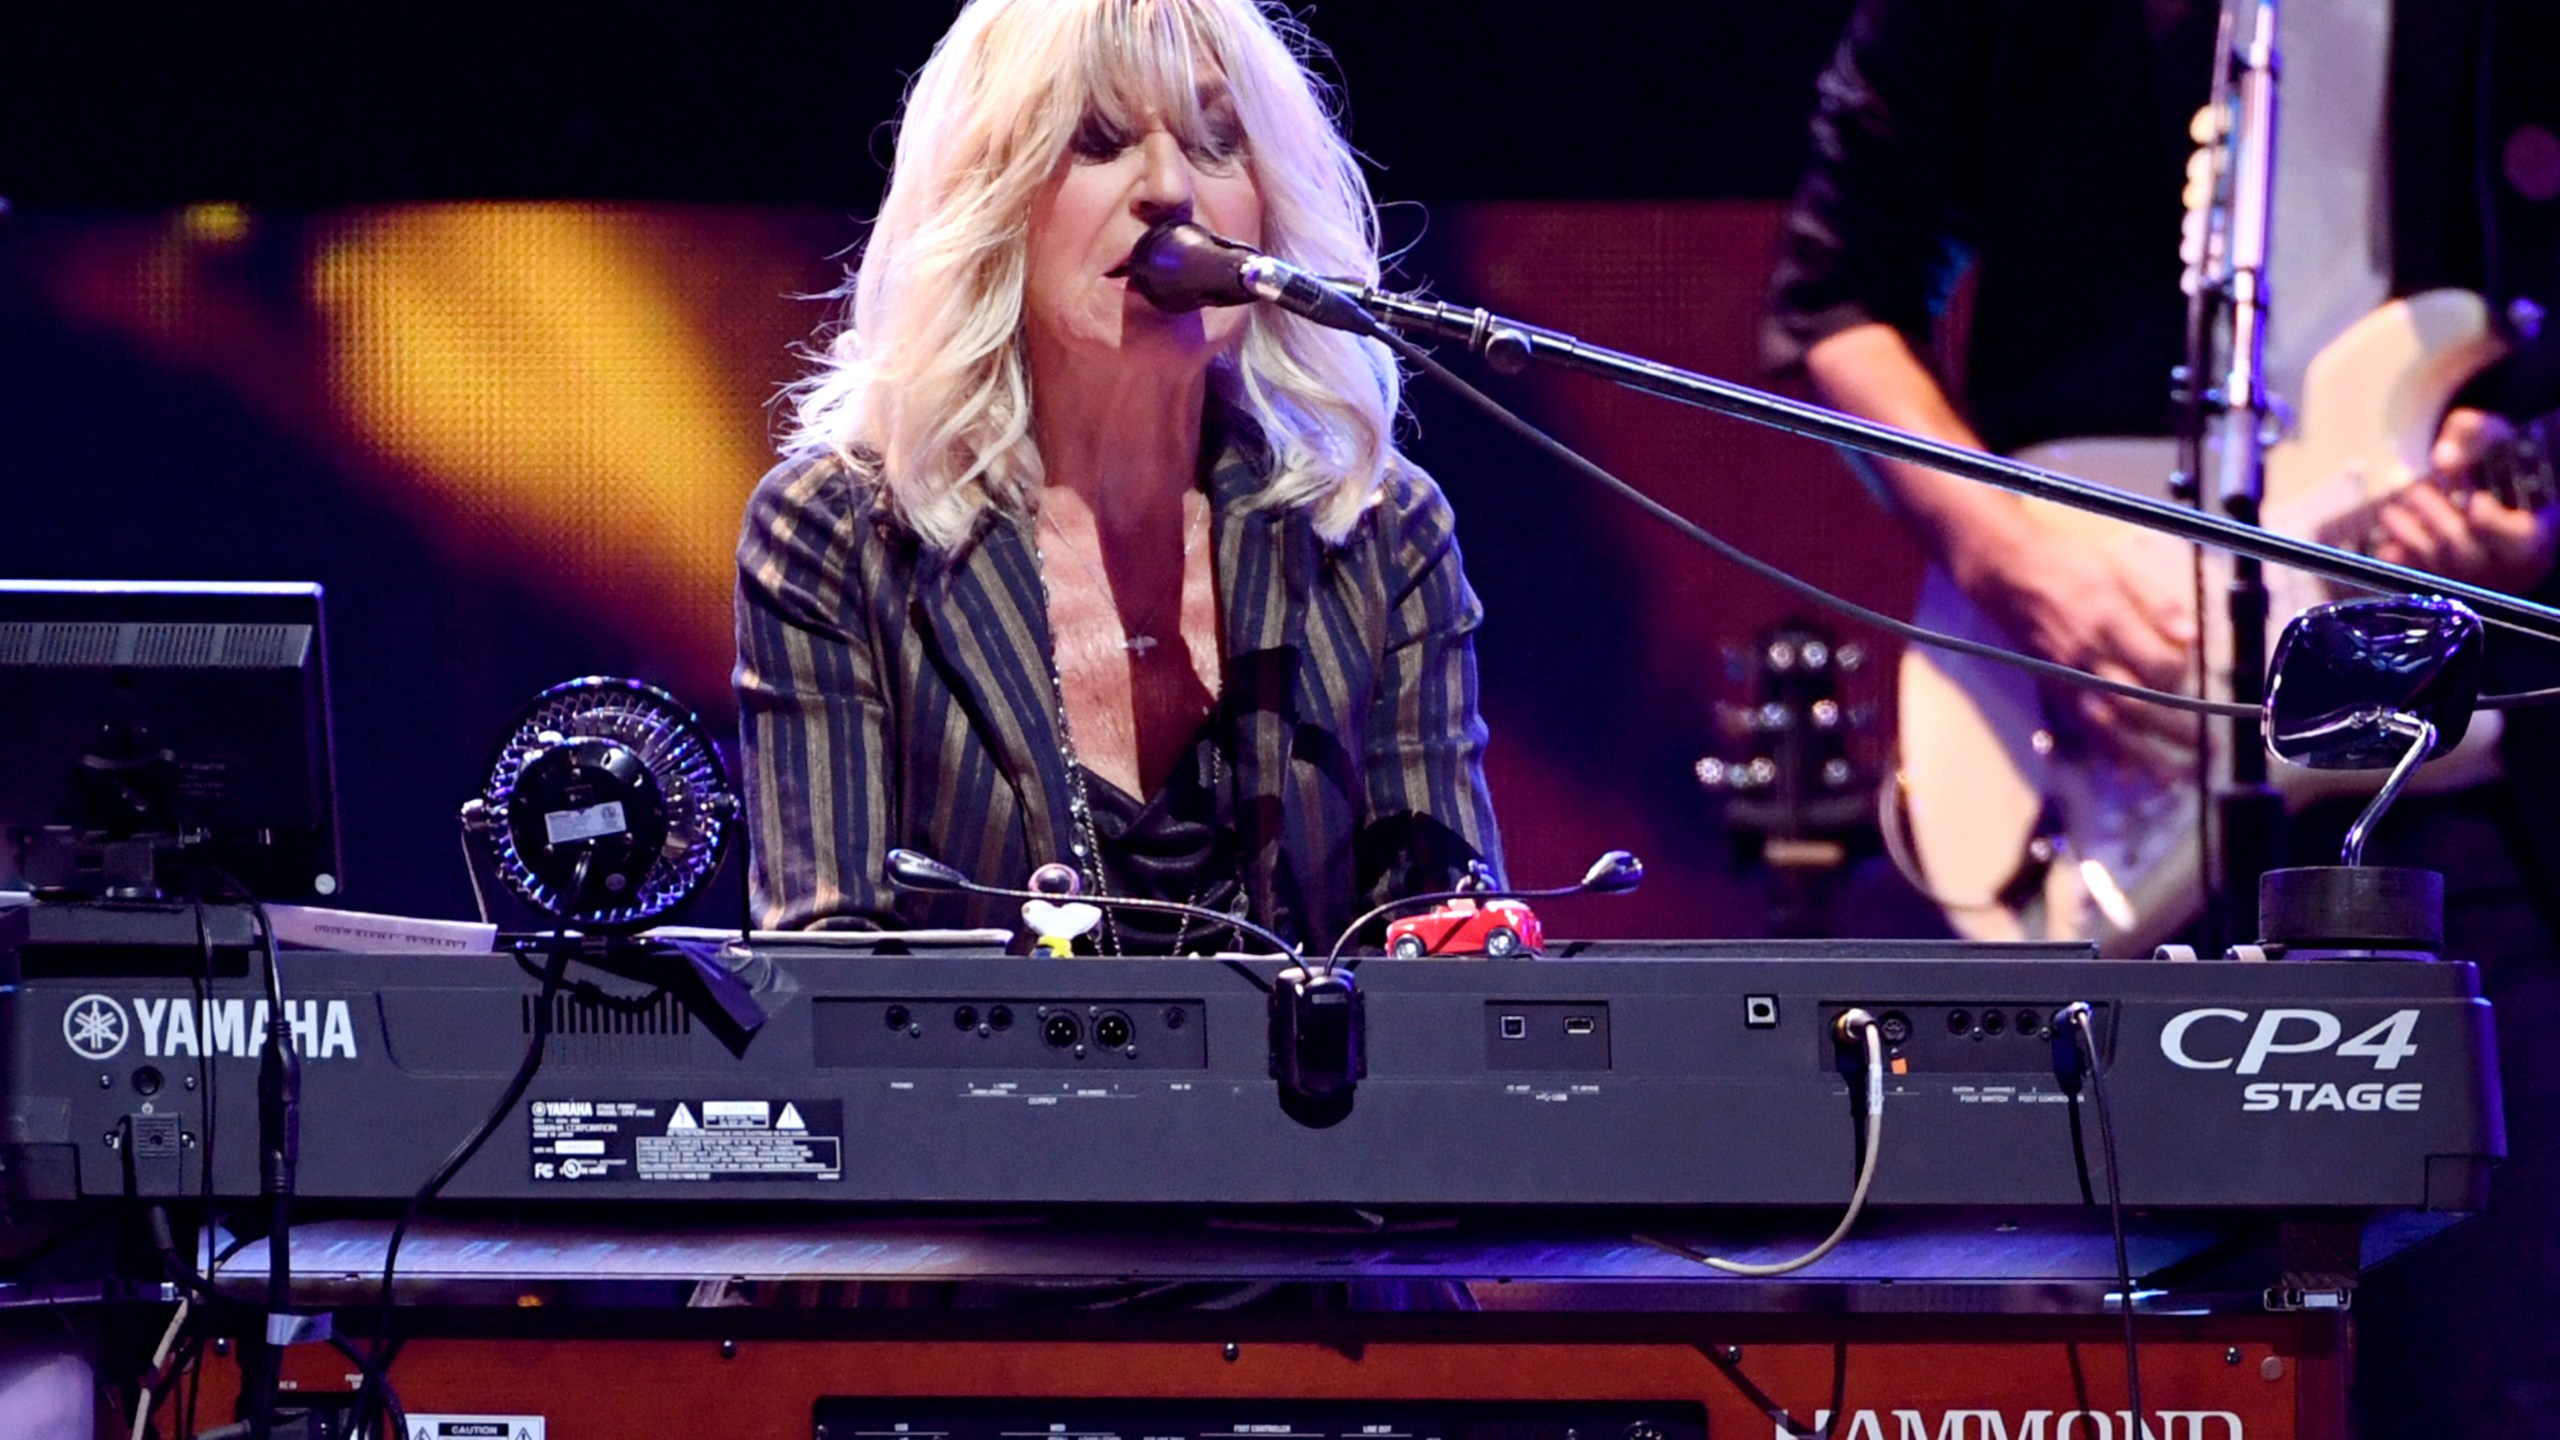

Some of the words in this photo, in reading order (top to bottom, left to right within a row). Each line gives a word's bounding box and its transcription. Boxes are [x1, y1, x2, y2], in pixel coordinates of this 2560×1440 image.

[133, 998, 357, 1058] YAMAHA
[2160, 1008, 2421, 1075] CP4
[546, 1102, 593, 1117] YAMAHA
[2243, 1083, 2423, 1111] STAGE
[451, 1425, 498, 1435] CAUTION
